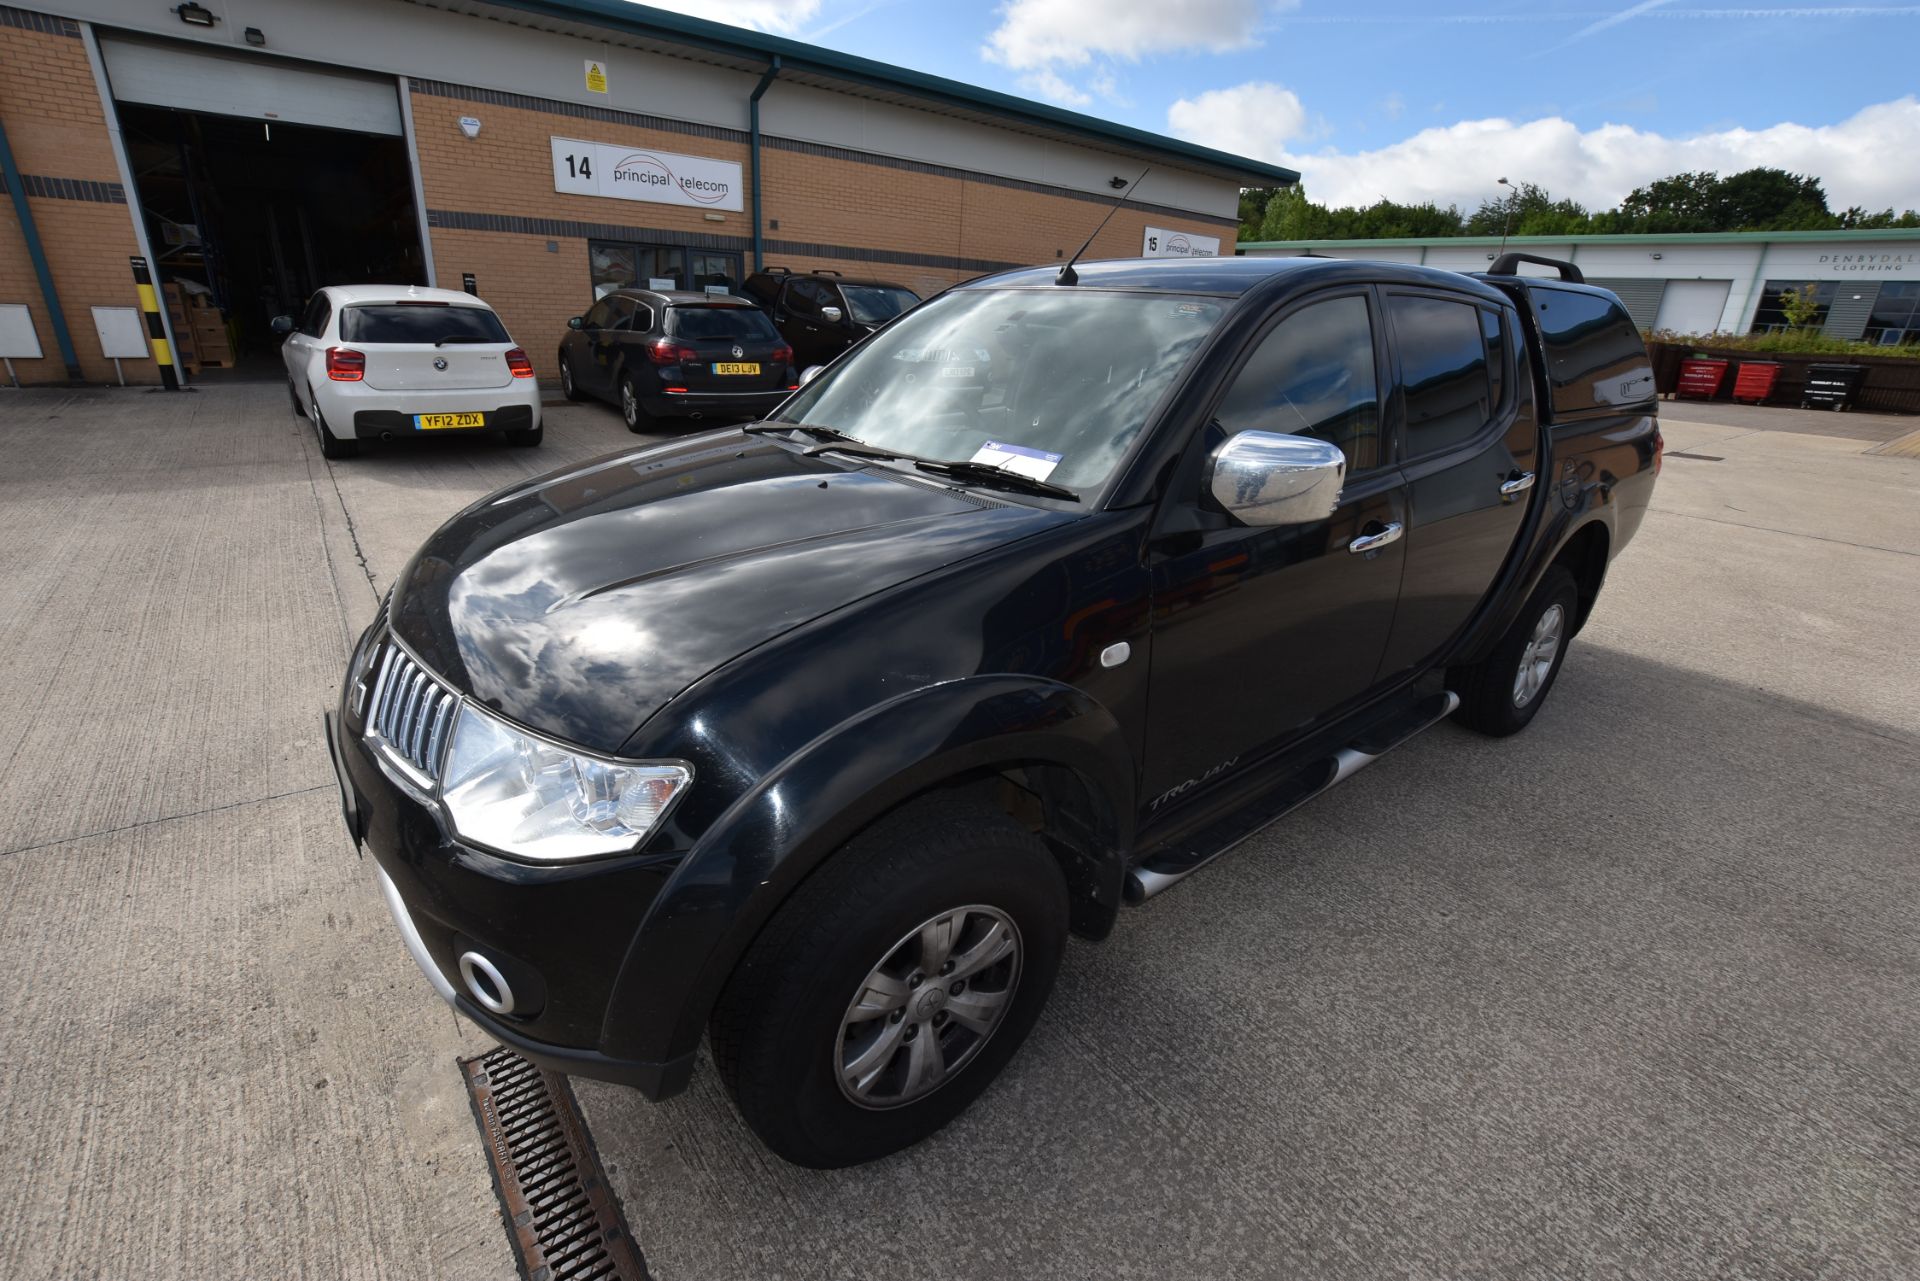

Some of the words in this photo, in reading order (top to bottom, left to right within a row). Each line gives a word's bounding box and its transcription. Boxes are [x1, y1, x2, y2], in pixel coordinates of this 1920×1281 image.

[565, 154, 592, 180] 14
[613, 168, 670, 187] principal
[680, 176, 729, 193] telecom
[1148, 236, 1158, 252] 15
[1166, 243, 1190, 254] principal
[1819, 254, 1920, 263] DENBYDAL
[1833, 264, 1903, 272] CLOTHING
[720, 364, 740, 373] DE13
[425, 415, 453, 427] YF12
[456, 414, 479, 425] ZDX
[1149, 756, 1239, 811] TROJAN
[492, 1127, 509, 1166] FASERFIX
